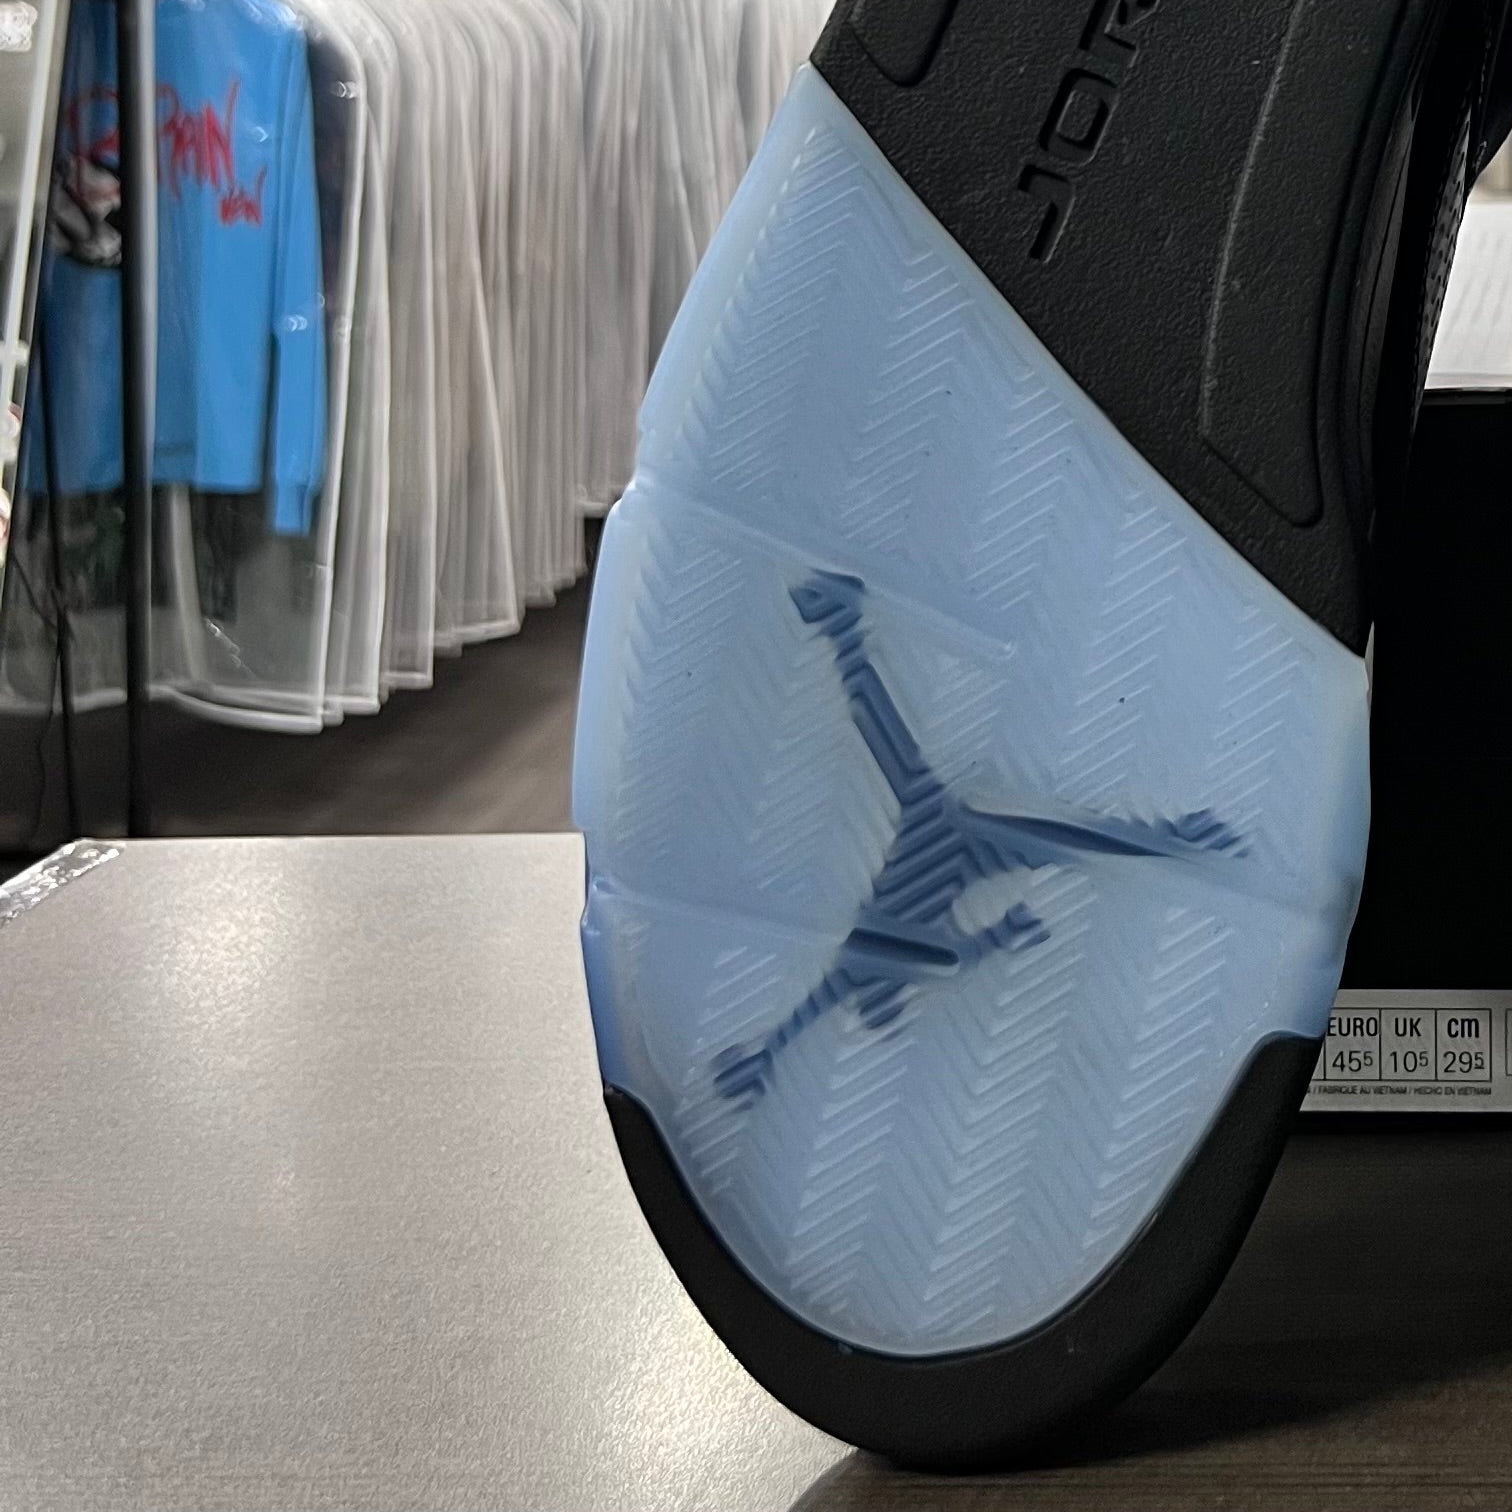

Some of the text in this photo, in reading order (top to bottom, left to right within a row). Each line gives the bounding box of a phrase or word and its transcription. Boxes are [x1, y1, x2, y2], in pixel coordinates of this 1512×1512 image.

[1327, 1017, 1480, 1038] EURO UK cm
